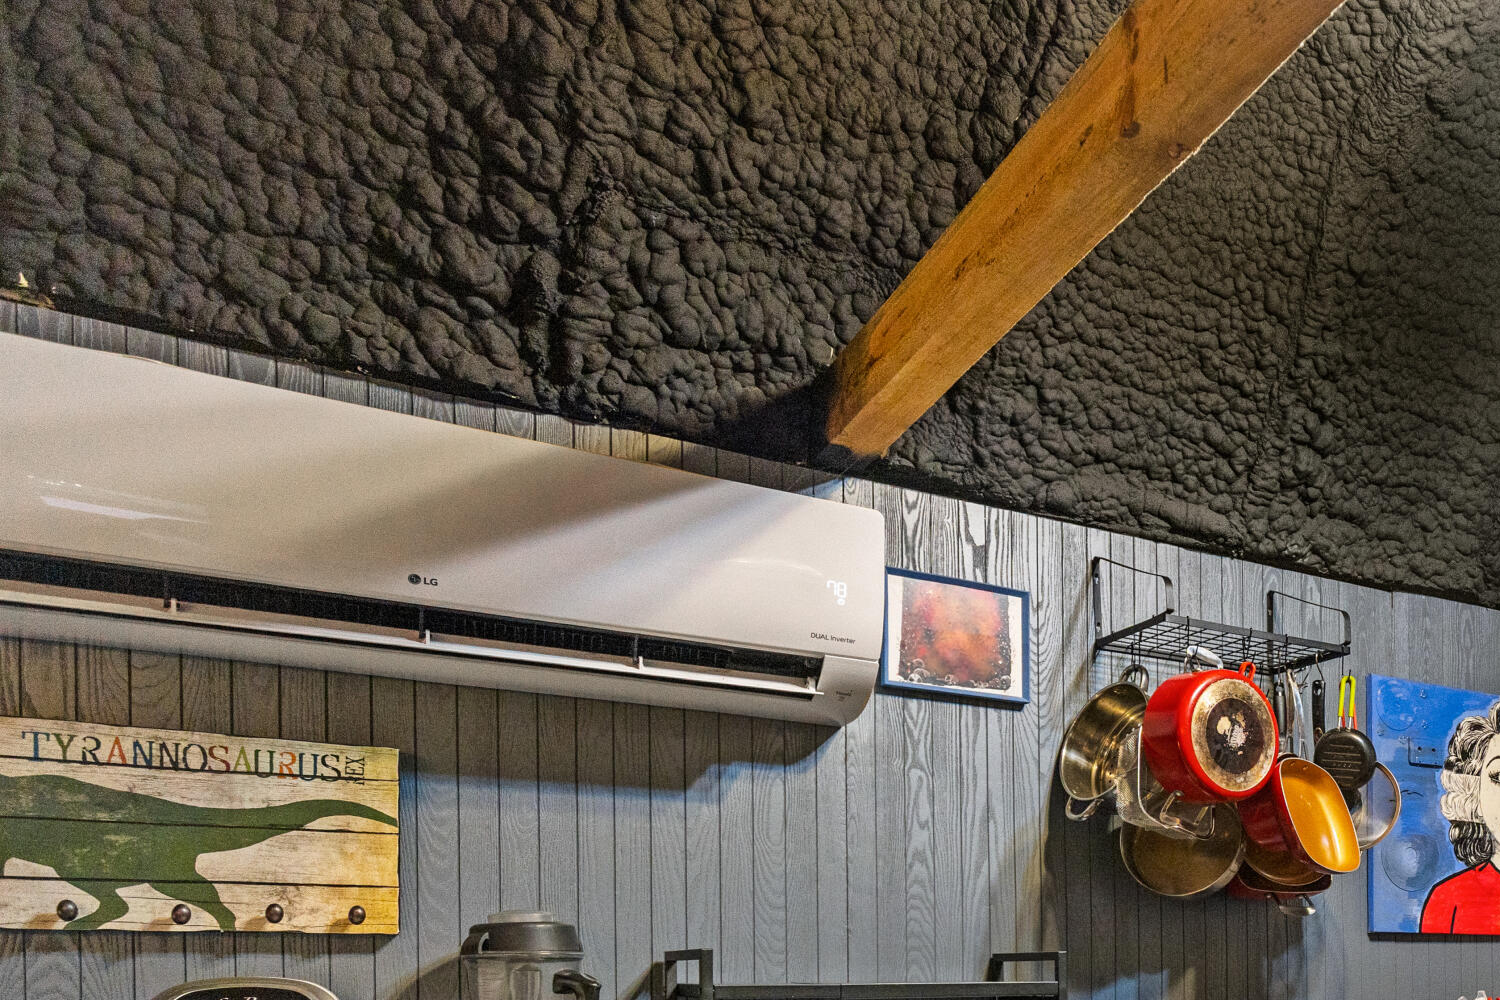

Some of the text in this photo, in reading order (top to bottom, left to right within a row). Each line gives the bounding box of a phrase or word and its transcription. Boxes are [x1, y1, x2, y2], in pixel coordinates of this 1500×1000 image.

[423, 577, 438, 586] LG
[826, 579, 847, 598] 78
[810, 632, 856, 644] DUAL Inverter
[22, 730, 343, 782] TYRANNOSAURUS
